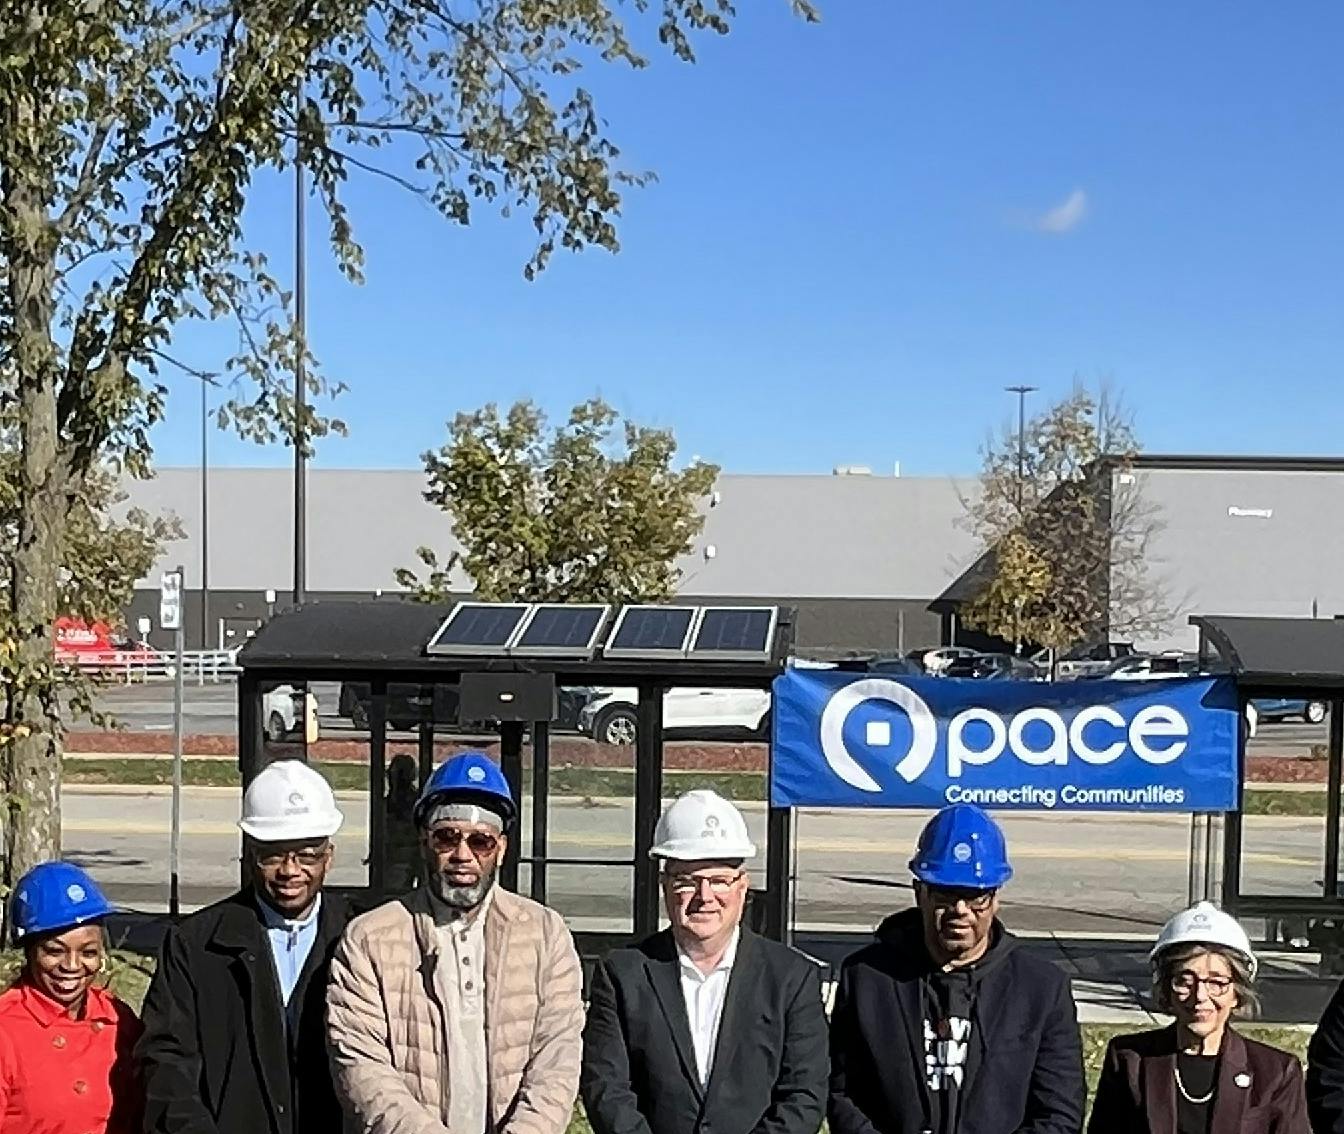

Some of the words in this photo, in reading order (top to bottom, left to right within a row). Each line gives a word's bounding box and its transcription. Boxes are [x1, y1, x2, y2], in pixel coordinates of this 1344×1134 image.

[946, 704, 1189, 777] pace
[945, 784, 1057, 808] Connecting
[1060, 784, 1185, 804] Communities
